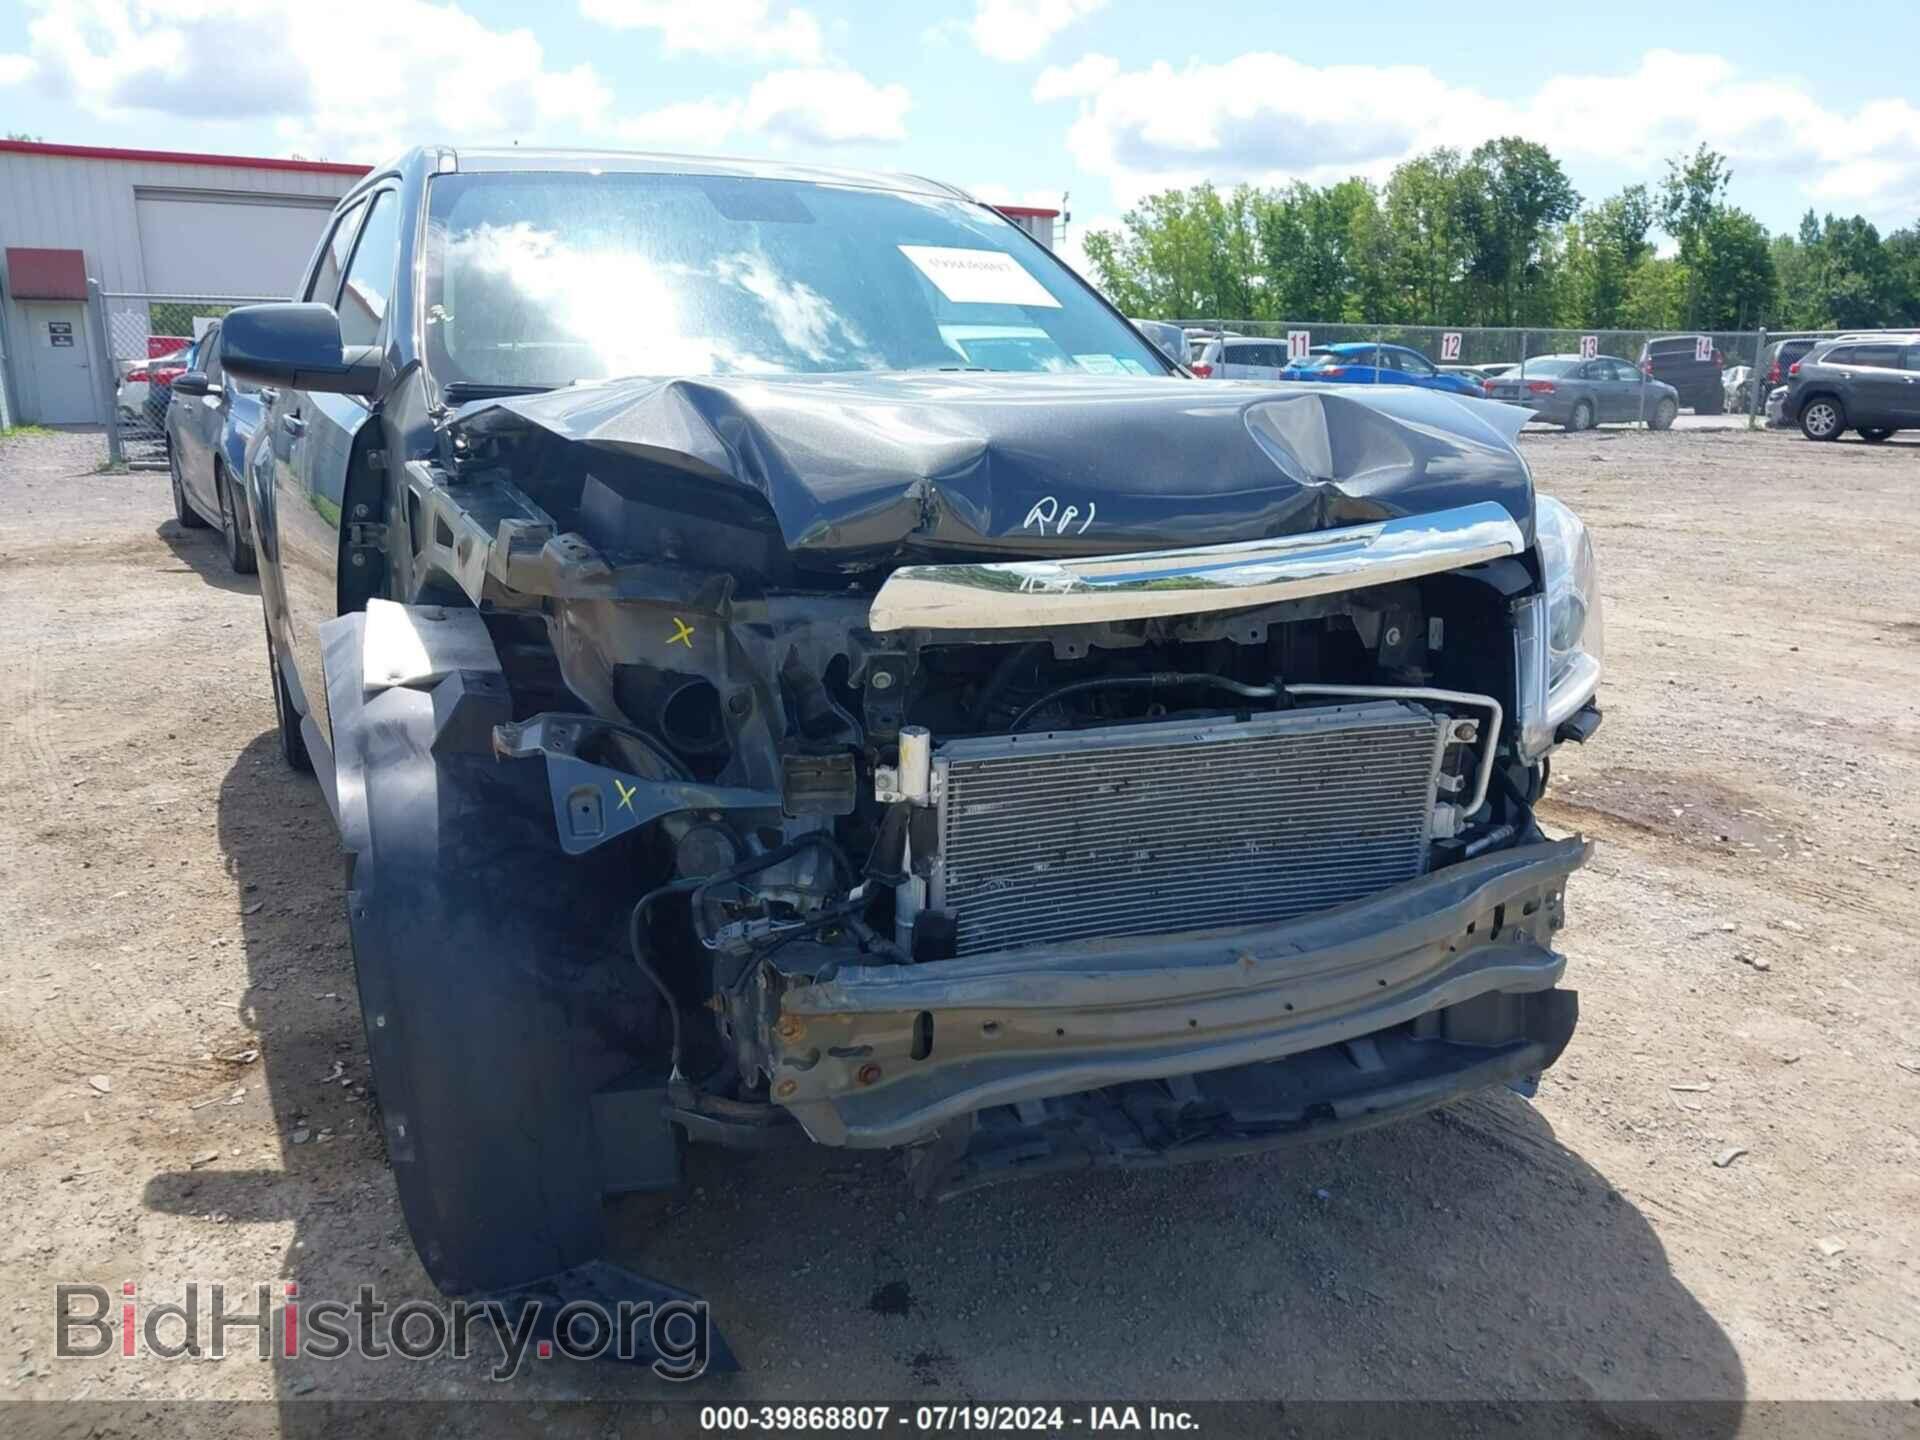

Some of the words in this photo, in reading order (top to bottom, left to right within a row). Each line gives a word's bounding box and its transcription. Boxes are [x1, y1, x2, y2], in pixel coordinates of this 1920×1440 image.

[1291, 333, 1307, 357] 11
[1445, 335, 1461, 357] 12
[1581, 337, 1596, 358] 13
[1697, 338, 1711, 359] 14
